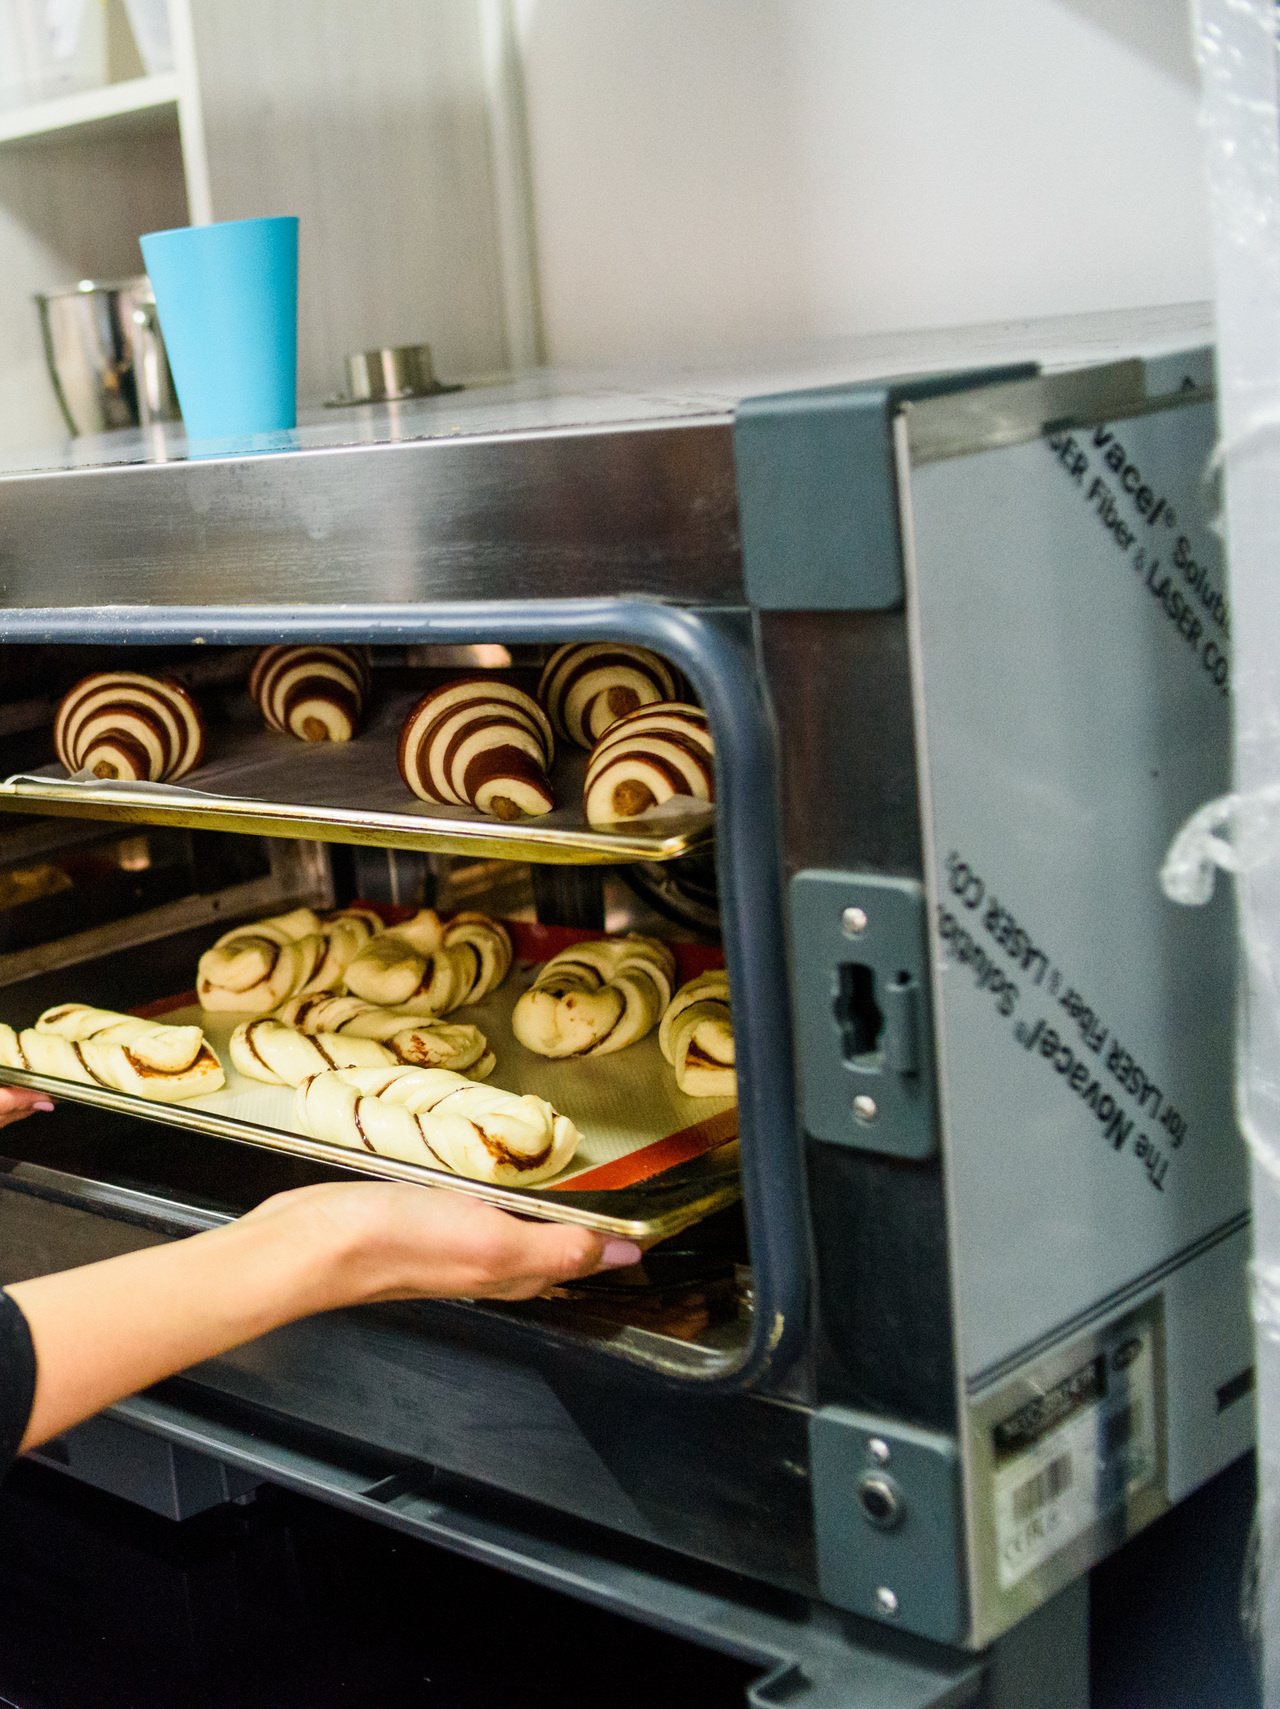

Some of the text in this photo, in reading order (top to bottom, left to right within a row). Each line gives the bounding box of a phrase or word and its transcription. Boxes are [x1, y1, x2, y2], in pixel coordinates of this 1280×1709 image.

[1086, 477, 1136, 551] Fiber
[1145, 561, 1203, 651] LASER
[982, 894, 1049, 986] LASER
[1058, 986, 1110, 1055] Fiber
[1103, 1038, 1166, 1119] LASER
[1133, 1133, 1170, 1192] The
[1159, 1107, 1188, 1150] for
